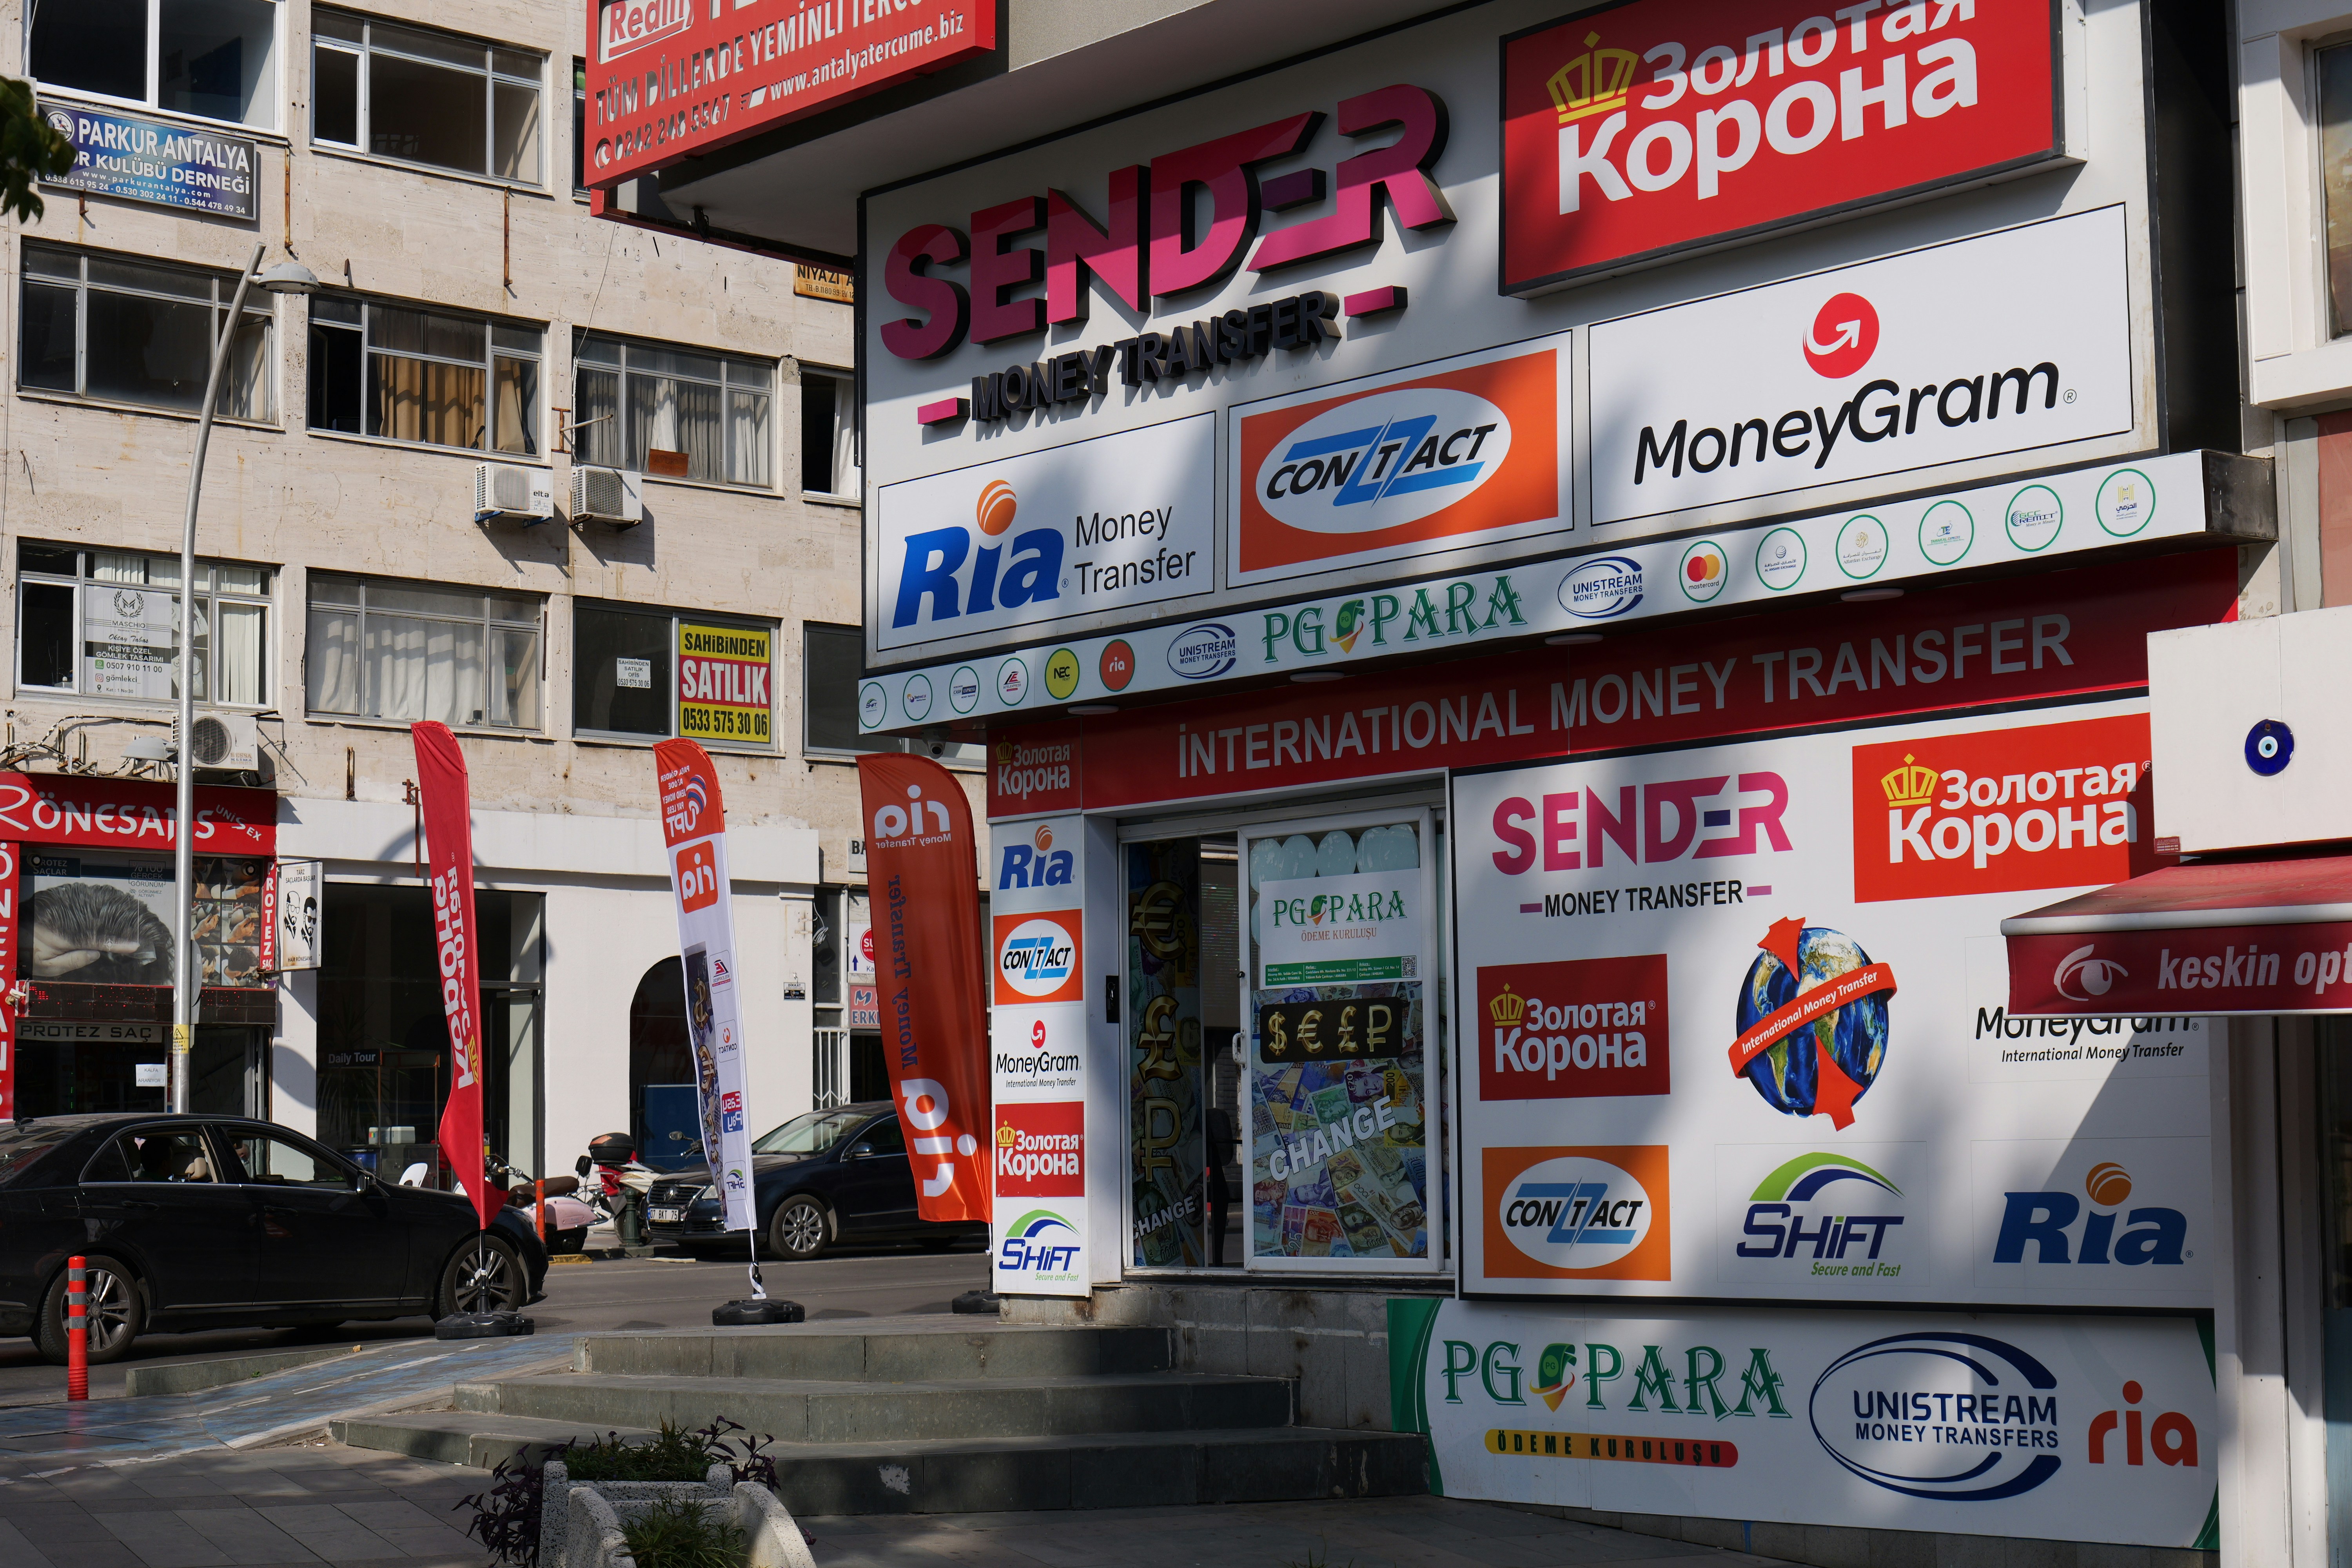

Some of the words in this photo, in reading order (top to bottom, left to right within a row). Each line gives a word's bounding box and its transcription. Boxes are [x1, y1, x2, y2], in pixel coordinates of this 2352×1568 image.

[595, 74, 638, 126] TÜM
[645, 35, 744, 107] DİLLERDE
[615, 123, 652, 160] 0242
[657, 110, 686, 145] 248
[690, 93, 730, 132] 5567
[770, 9, 964, 101] www.antalyatercume.biz
[1559, 38, 1978, 215] Корона
[79, 118, 158, 156] PARKUR
[162, 134, 250, 172] ANTALYA
[82, 171, 211, 198] www.parkurantalya.com
[96, 154, 167, 180] KULÜBÜ
[172, 167, 249, 194] DERNEĞİ
[45, 174, 67, 183] 0.538
[69, 178, 84, 187] 615
[99, 183, 109, 191] 24
[116, 186, 137, 196] 0.530
[140, 190, 154, 199] 302
[156, 192, 166, 200] 24
[184, 197, 206, 207] 0.544
[208, 201, 222, 210] 478
[236, 206, 245, 214] 34
[880, 83, 1455, 359] SENDER
[797, 265, 839, 284] NIYAZI
[971, 344, 1111, 422] MONEY
[1114, 290, 1341, 387] TRANSFER
[1633, 361, 2059, 485] MoneyGram
[1266, 422, 1497, 501] CONTACT
[1076, 505, 1172, 549] Money
[2020, 513, 2055, 523] REMIT
[892, 480, 1065, 629] Ria
[1074, 548, 1196, 595] Transfer
[1573, 573, 1642, 594] UNISTREAM
[1573, 592, 1599, 602] MONEY
[1601, 585, 1642, 597] TRANSFERS
[1688, 580, 1719, 590] mastercard
[1261, 606, 1328, 664] PG
[1369, 575, 1528, 646] PARA
[108, 644, 131, 653] KİŞİYE
[132, 646, 152, 654] ÖZEL
[109, 634, 127, 642] Oktay
[1180, 638, 1236, 657] UNISTREAM
[96, 651, 127, 659] GÖMLEK
[129, 654, 163, 662] TASARIMI
[1054, 666, 1070, 679] NEC
[1109, 656, 1125, 672] ria
[1180, 653, 1200, 664] MONEY
[1201, 649, 1236, 661] TRANSFERS
[682, 659, 767, 704] SATILIK
[1179, 690, 1534, 778] İNTERNATIONAL
[1551, 658, 1737, 730] MONEY
[1753, 614, 2074, 704] TRANSFER
[683, 708, 710, 731] 0533
[713, 710, 734, 733] 575
[737, 711, 751, 735] 30
[754, 713, 768, 737] 06
[1013, 744, 1070, 767] Золотая
[998, 765, 1070, 800] Корона
[1939, 761, 2136, 810] Золотая
[1492, 771, 1794, 875] SENDER
[1889, 800, 2137, 869] Корона
[999, 825, 1074, 890] Ria
[1273, 897, 1305, 927] PG
[1329, 890, 1407, 924] PARA
[1545, 889, 1619, 917] MONEY
[1626, 880, 1744, 911] TRANSFER
[1301, 927, 1329, 941] ÖDEME
[1332, 926, 1377, 942] KURULUŞU
[262, 959, 272, 971] SAÇ
[1004, 947, 1071, 969] CONTACT
[2158, 945, 2280, 989] keskin
[1526, 998, 1646, 1031] Золотая
[1742, 1007, 1802, 1054] International
[1804, 991, 1837, 1016] Money
[1837, 970, 1878, 997] Transfer
[20, 1025, 100, 1037] PROTEZ
[110, 1027, 152, 1042] SAÇ
[328, 1053, 352, 1065] Daily
[354, 1052, 376, 1062] Tour
[996, 1051, 1078, 1078] MoneyGram
[1495, 1027, 1646, 1081] Корона
[2002, 1046, 2082, 1063] International
[2086, 1045, 2130, 1062] Money
[2132, 1043, 2184, 1058] Transfer
[1005, 1078, 1038, 1088] International
[1038, 1079, 1056, 1089] Money
[1056, 1078, 1076, 1087] Transfer
[1016, 1131, 1079, 1151] Золотая
[1269, 1095, 1396, 1182] CHANGE
[998, 1148, 1079, 1182] Корона
[650, 1209, 656, 1219] 07
[659, 1210, 668, 1219] BKT
[671, 1211, 678, 1220] 75
[1506, 1200, 1642, 1229] CONTACT
[1993, 1162, 2187, 1265] Ria
[1035, 1272, 1054, 1281] Secure
[1055, 1272, 1065, 1281] and
[1067, 1273, 1079, 1281] Fast
[1810, 1261, 1848, 1277] Secure
[1850, 1261, 1873, 1278] and
[1876, 1262, 1901, 1278] Fast
[1443, 1338, 1525, 1405] PG
[1584, 1342, 1793, 1420] PARA
[1853, 1390, 2057, 1426] UNISTREAM
[2088, 1379, 2198, 1466] ria
[1497, 1428, 1574, 1457] ÖDEME
[1590, 1434, 1724, 1466] KURULUŞU
[1855, 1423, 1926, 1444] MONEY
[1931, 1424, 2060, 1448] TRANSFERS
